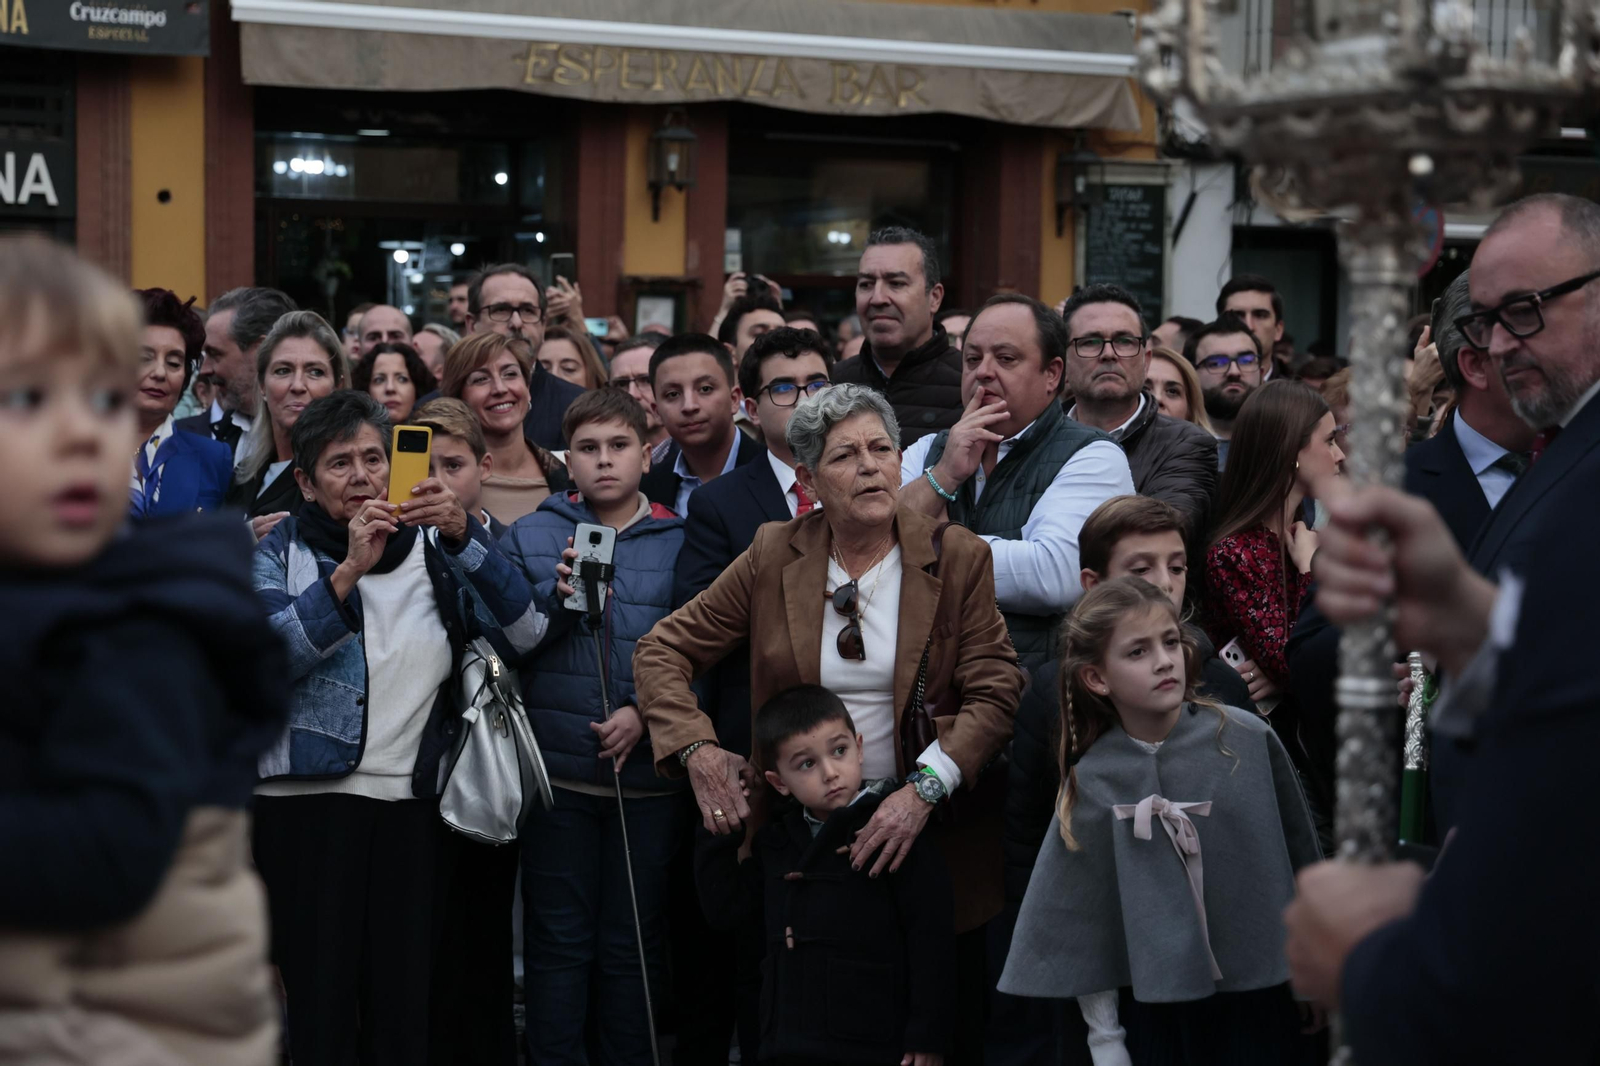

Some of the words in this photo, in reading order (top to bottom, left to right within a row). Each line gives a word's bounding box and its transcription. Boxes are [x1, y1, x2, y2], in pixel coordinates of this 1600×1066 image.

[69, 1, 167, 29] Cruzcampo
[88, 25, 149, 42] ESPECIAL
[516, 41, 805, 98] ESPERANZA
[829, 61, 929, 108] BAR
